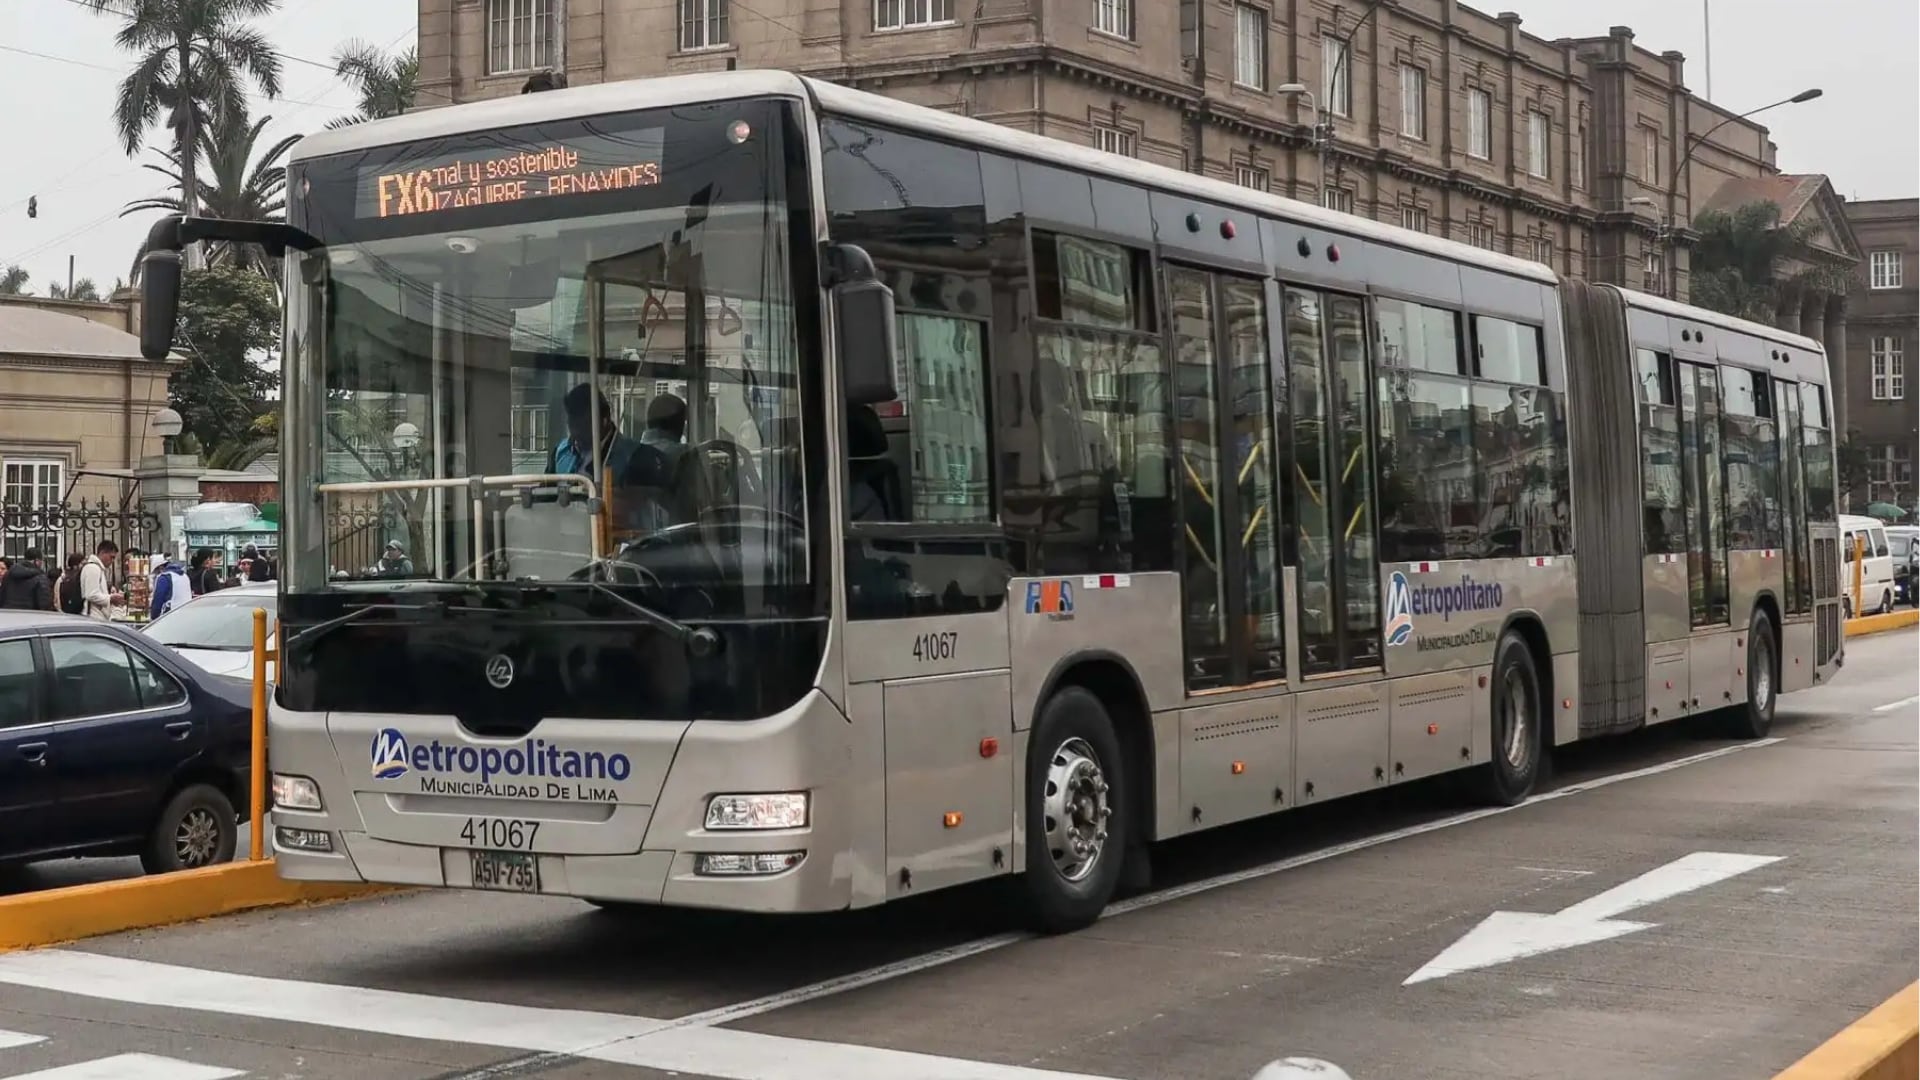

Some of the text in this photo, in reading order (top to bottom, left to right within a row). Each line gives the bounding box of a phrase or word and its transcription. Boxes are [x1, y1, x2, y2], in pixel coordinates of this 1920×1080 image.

[469, 162, 481, 186] y
[486, 145, 578, 179] sostenible
[378, 170, 433, 218] FX6
[1385, 571, 1503, 634] Metropolitano
[913, 632, 958, 662] 41067
[371, 728, 631, 783] Metropolitano
[421, 776, 539, 798] MUNICIPALIDAD
[577, 786, 618, 801] LIMA
[460, 818, 540, 850] 41067
[475, 860, 533, 887] A5V-735
